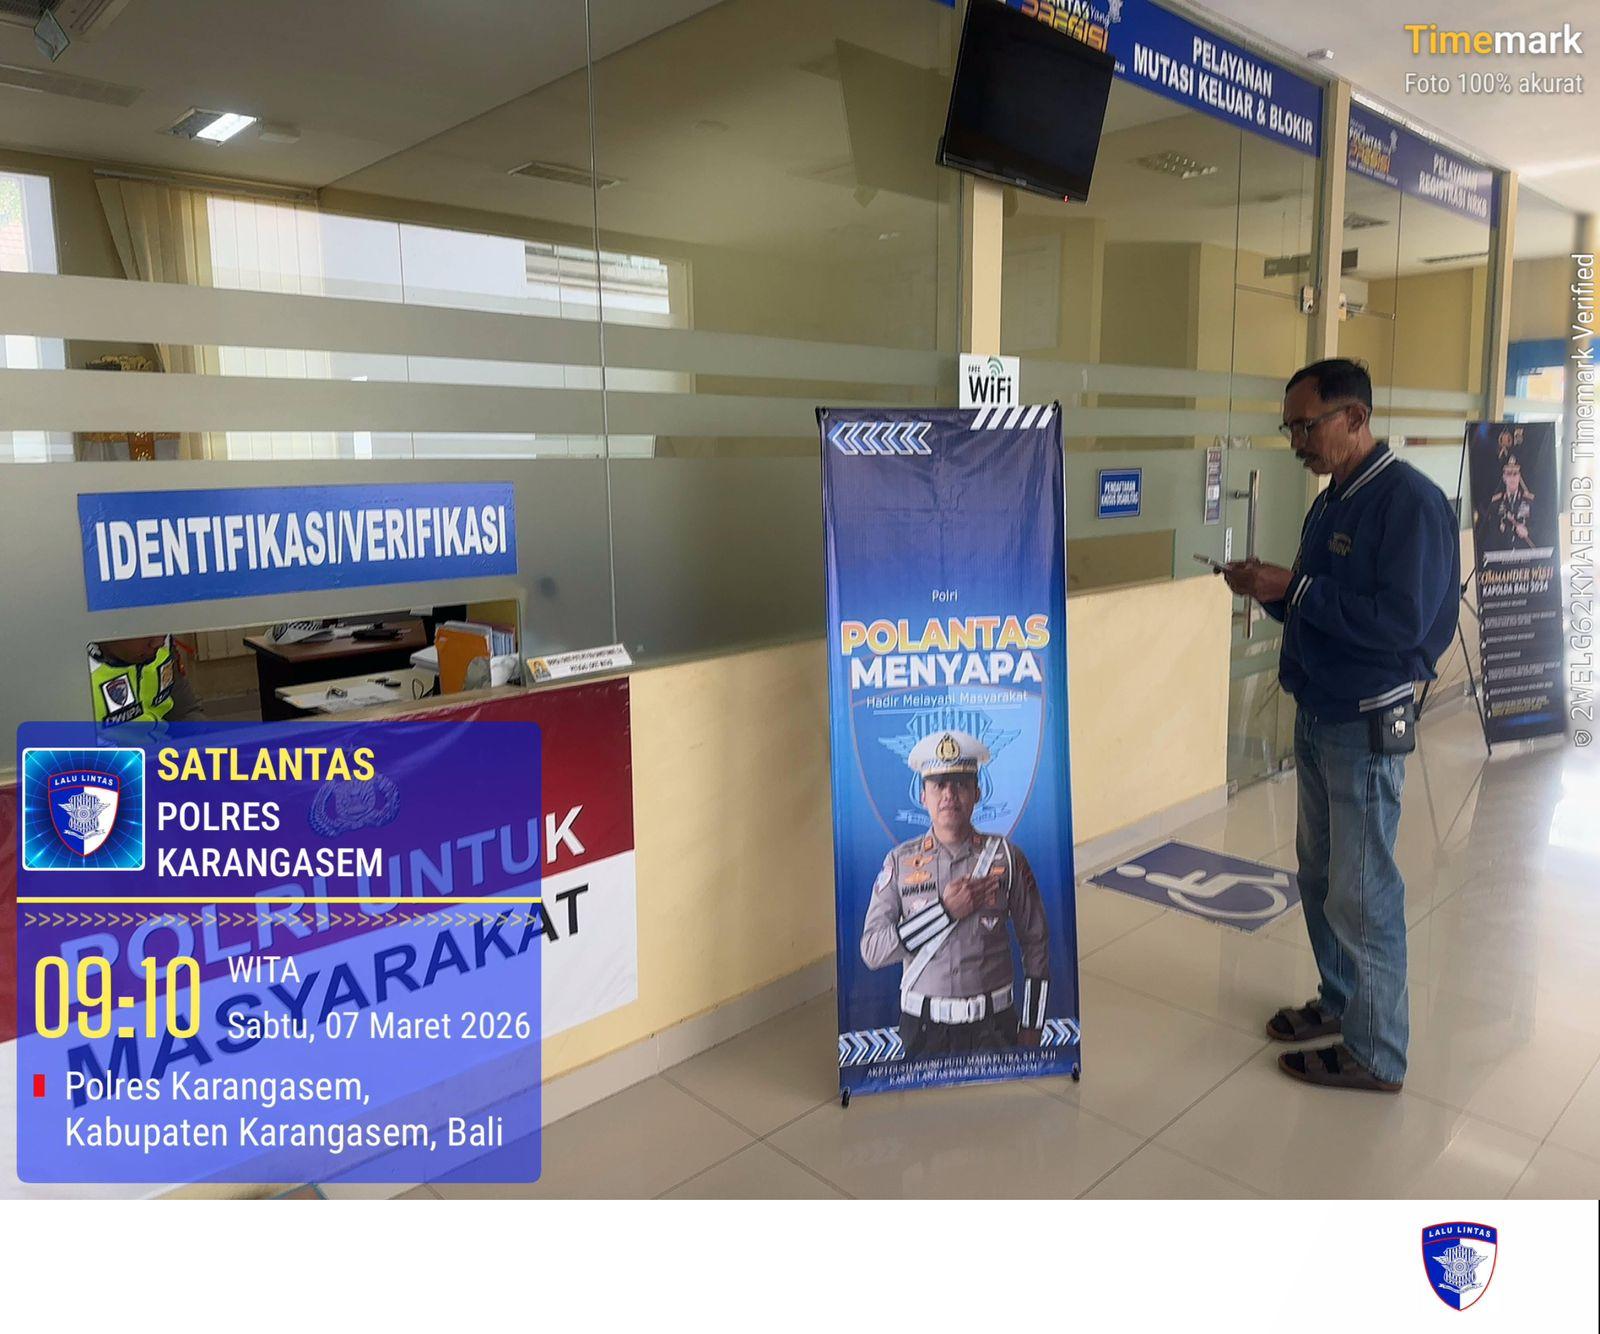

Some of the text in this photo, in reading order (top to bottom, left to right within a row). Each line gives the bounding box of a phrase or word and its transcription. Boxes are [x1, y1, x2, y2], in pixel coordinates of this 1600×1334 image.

[1192, 35, 1273, 99] PELAYANAN
[1133, 42, 1313, 146] MUTASI KELUAR & BLOKIR
[1432, 152, 1479, 191] PELAYANAN
[969, 376, 1011, 403] WiFi
[96, 505, 508, 583] IDENTIFIKASI/VERIFIKASI
[931, 588, 958, 603] Polri
[841, 613, 1051, 655] POLANTAS
[851, 650, 1043, 690] MENYAPA
[866, 688, 1027, 711] Hadir Melayani Masyarakat
[60, 804, 587, 984] POLRI UNTUK
[66, 883, 590, 1109] MASYARAKAT
